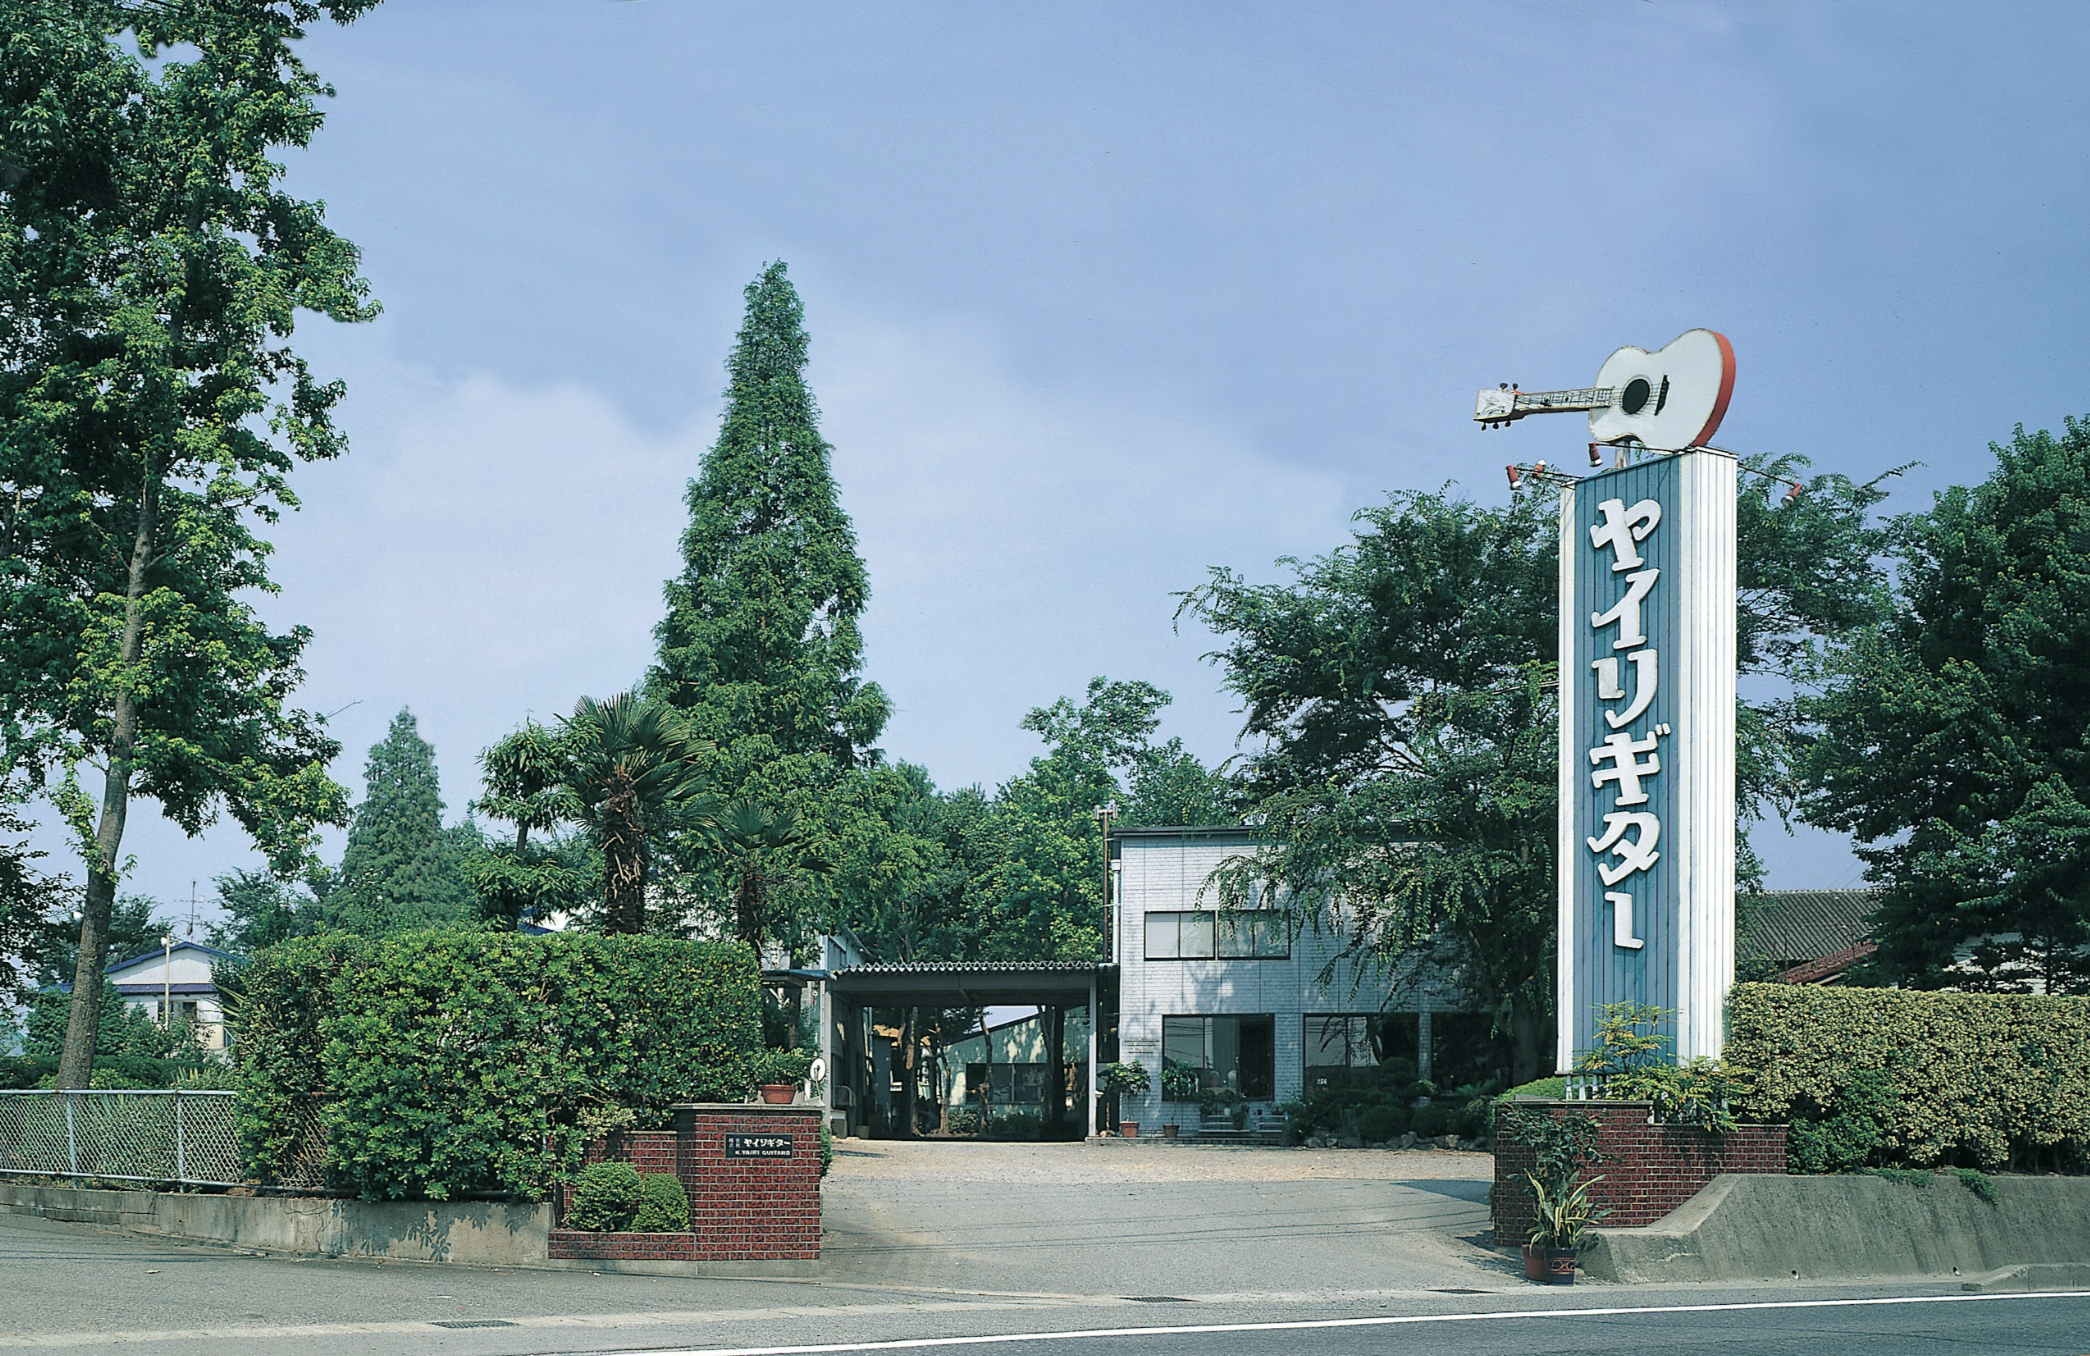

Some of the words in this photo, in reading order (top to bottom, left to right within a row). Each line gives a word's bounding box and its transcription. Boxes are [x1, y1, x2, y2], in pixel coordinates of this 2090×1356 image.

[1587, 498, 1671, 949] ヤイリギター
[743, 1138, 791, 1147] ヤイリギター
